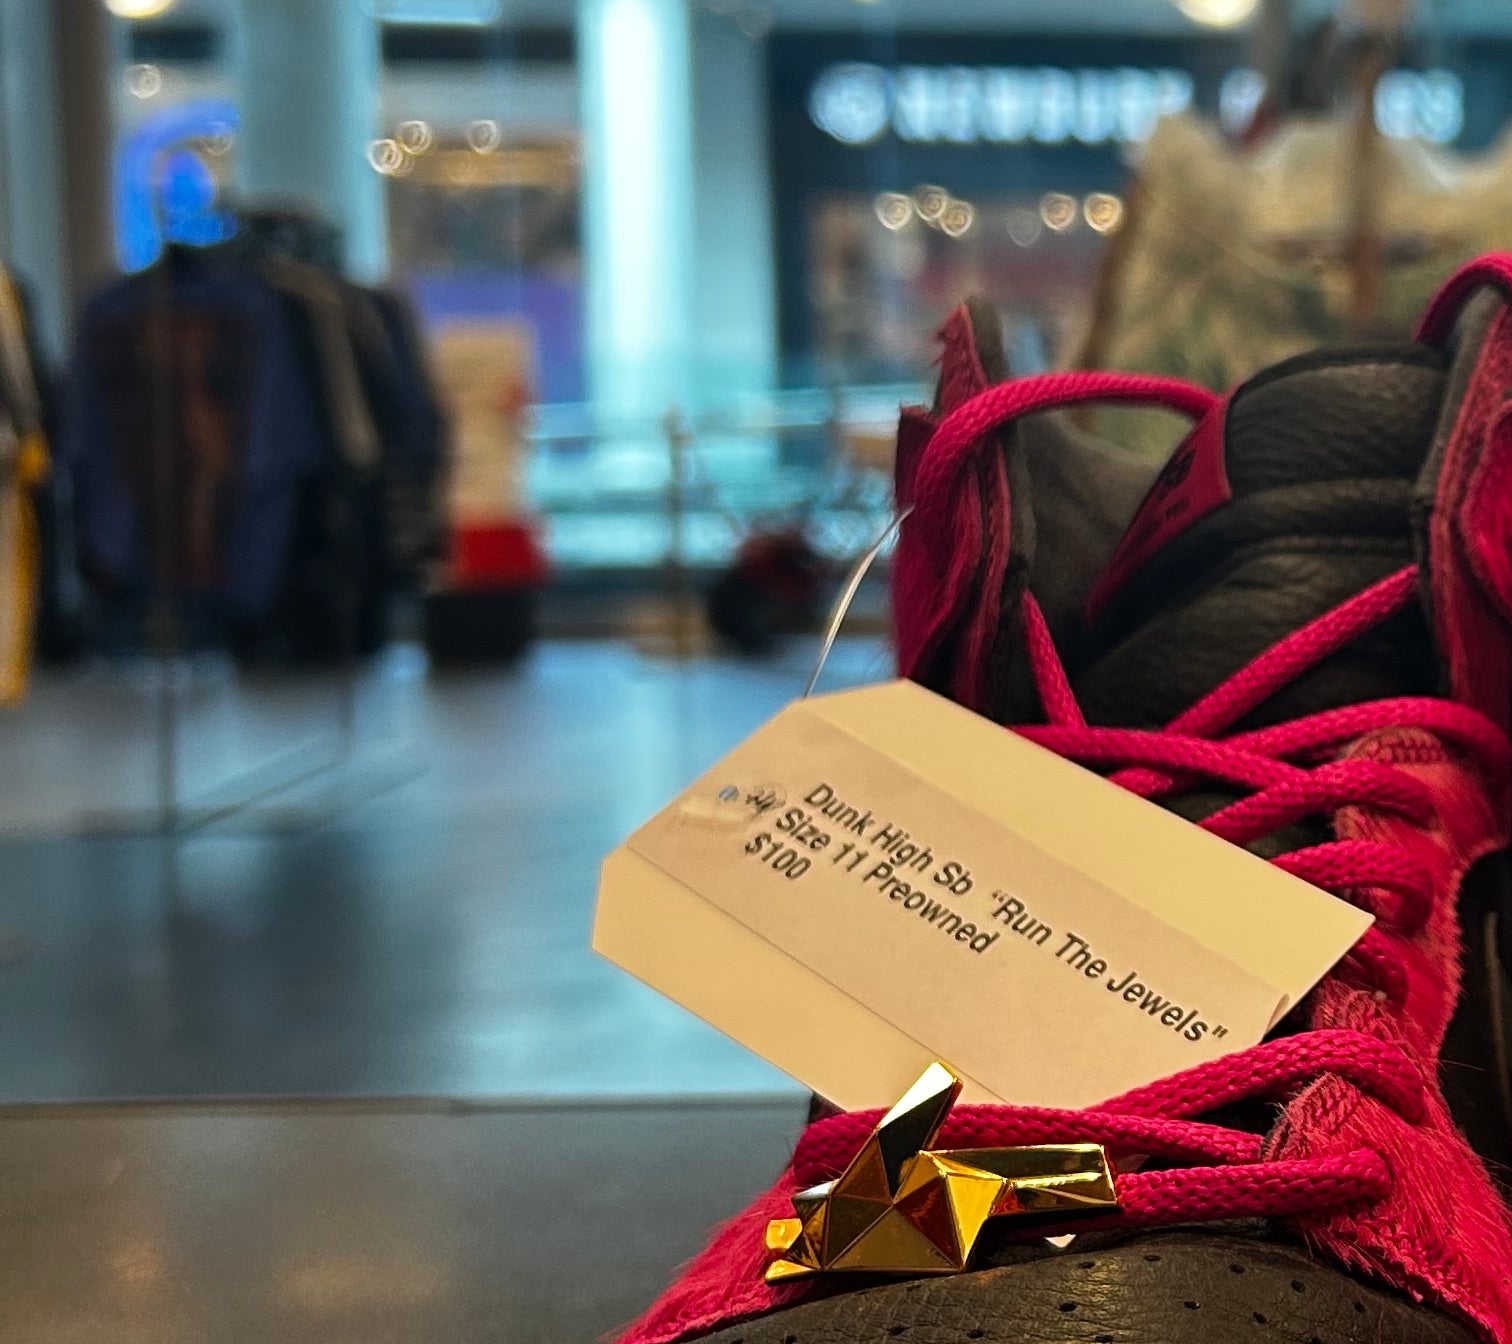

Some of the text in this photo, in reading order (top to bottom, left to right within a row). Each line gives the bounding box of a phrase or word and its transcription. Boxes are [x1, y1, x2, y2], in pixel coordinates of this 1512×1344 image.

[744, 830, 812, 881] $100
[775, 806, 1000, 954] Size 11 Preowned
[803, 782, 874, 837] Dunk
[869, 821, 935, 874] High
[933, 860, 974, 897] Sb
[1054, 931, 1108, 979] The
